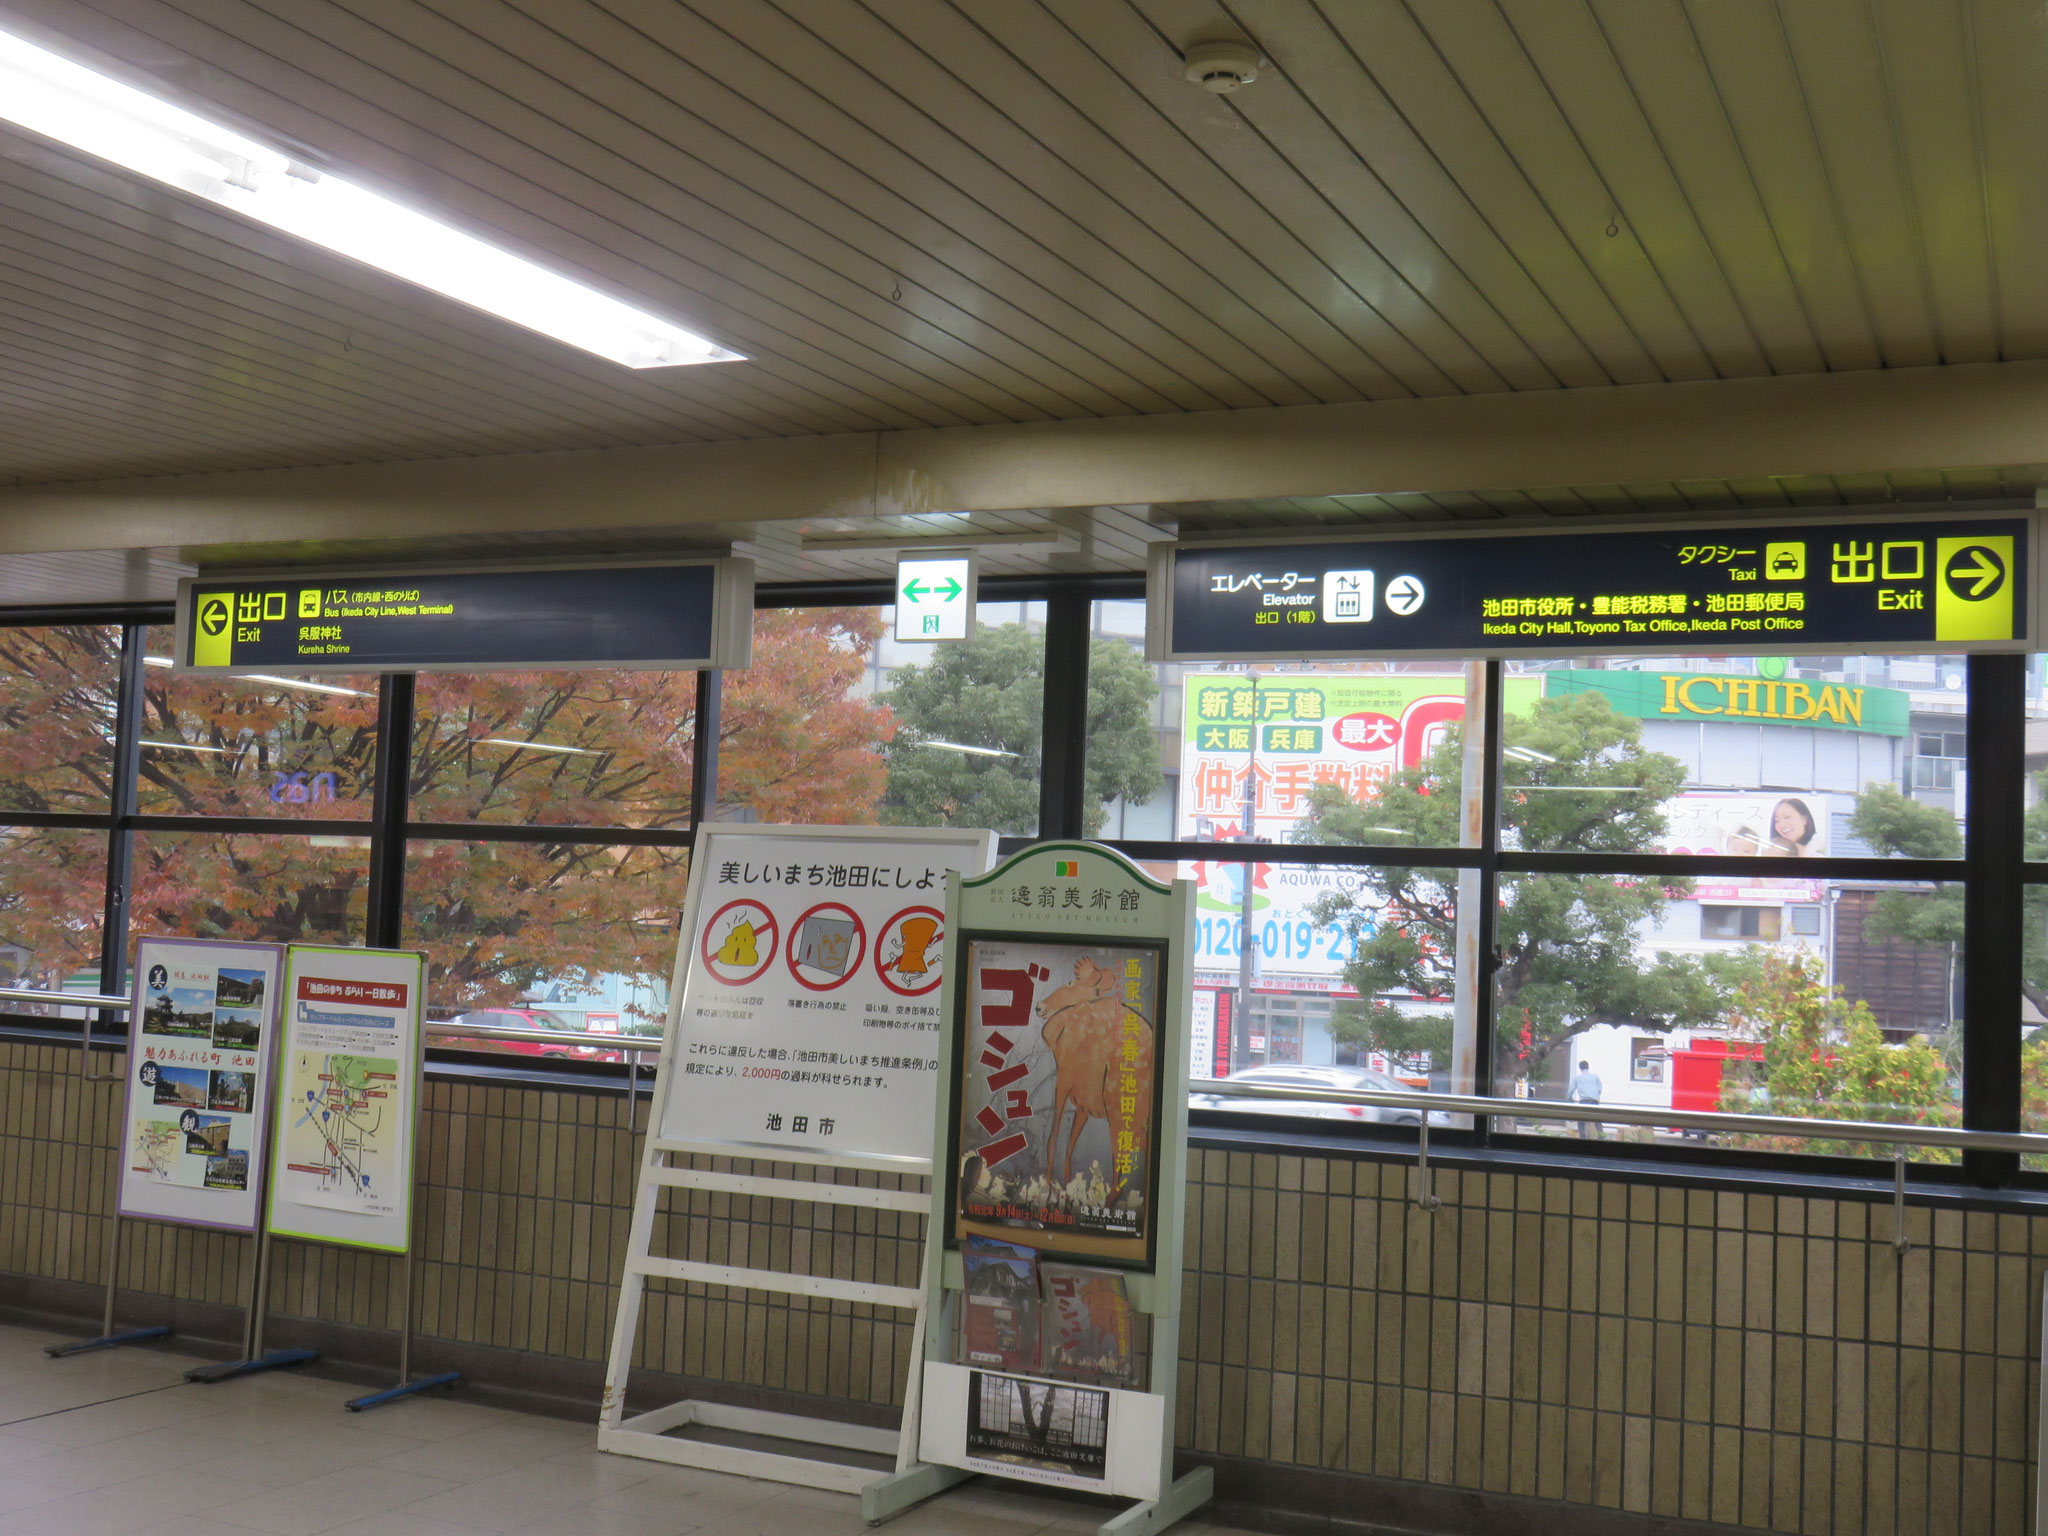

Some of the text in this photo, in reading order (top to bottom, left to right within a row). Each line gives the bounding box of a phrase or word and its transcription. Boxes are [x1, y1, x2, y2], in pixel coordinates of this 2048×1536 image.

[1678, 545, 1756, 566] タクシー
[1831, 540, 1924, 584] 出口
[1210, 572, 1316, 593] エレベーター
[1728, 567, 1757, 582] Taxi
[238, 592, 286, 623] 出口
[1263, 593, 1315, 606] Elevator
[1877, 589, 1924, 612] Exit
[324, 607, 339, 618] Bus
[341, 606, 363, 618] (Ikeda
[364, 606, 378, 618] City
[419, 604, 454, 616] Terminal)
[237, 628, 261, 642] Exit
[298, 626, 342, 641] 呉服神社
[1483, 622, 1516, 635] Ikeda
[1519, 621, 1545, 636] City
[1624, 619, 1646, 633] Tax
[1730, 617, 1761, 632] Post
[1764, 616, 1804, 631] Office
[298, 643, 350, 654] Kureha Shrine
[1201, 689, 1323, 720] 新築戸建
[1659, 675, 1865, 728] ICHIBAN
[1204, 727, 1249, 750] 大阪
[1269, 728, 1316, 750] 兵庫
[1339, 720, 1394, 744] 最大
[1280, 873, 1331, 887] AQUWA
[1011, 885, 1140, 911] 逸翁美術館
[1056, 914, 1079, 922] ART
[1086, 915, 1139, 924] MUSEUM
[152, 969, 165, 989] 美
[976, 962, 1051, 1168] ゴシュン
